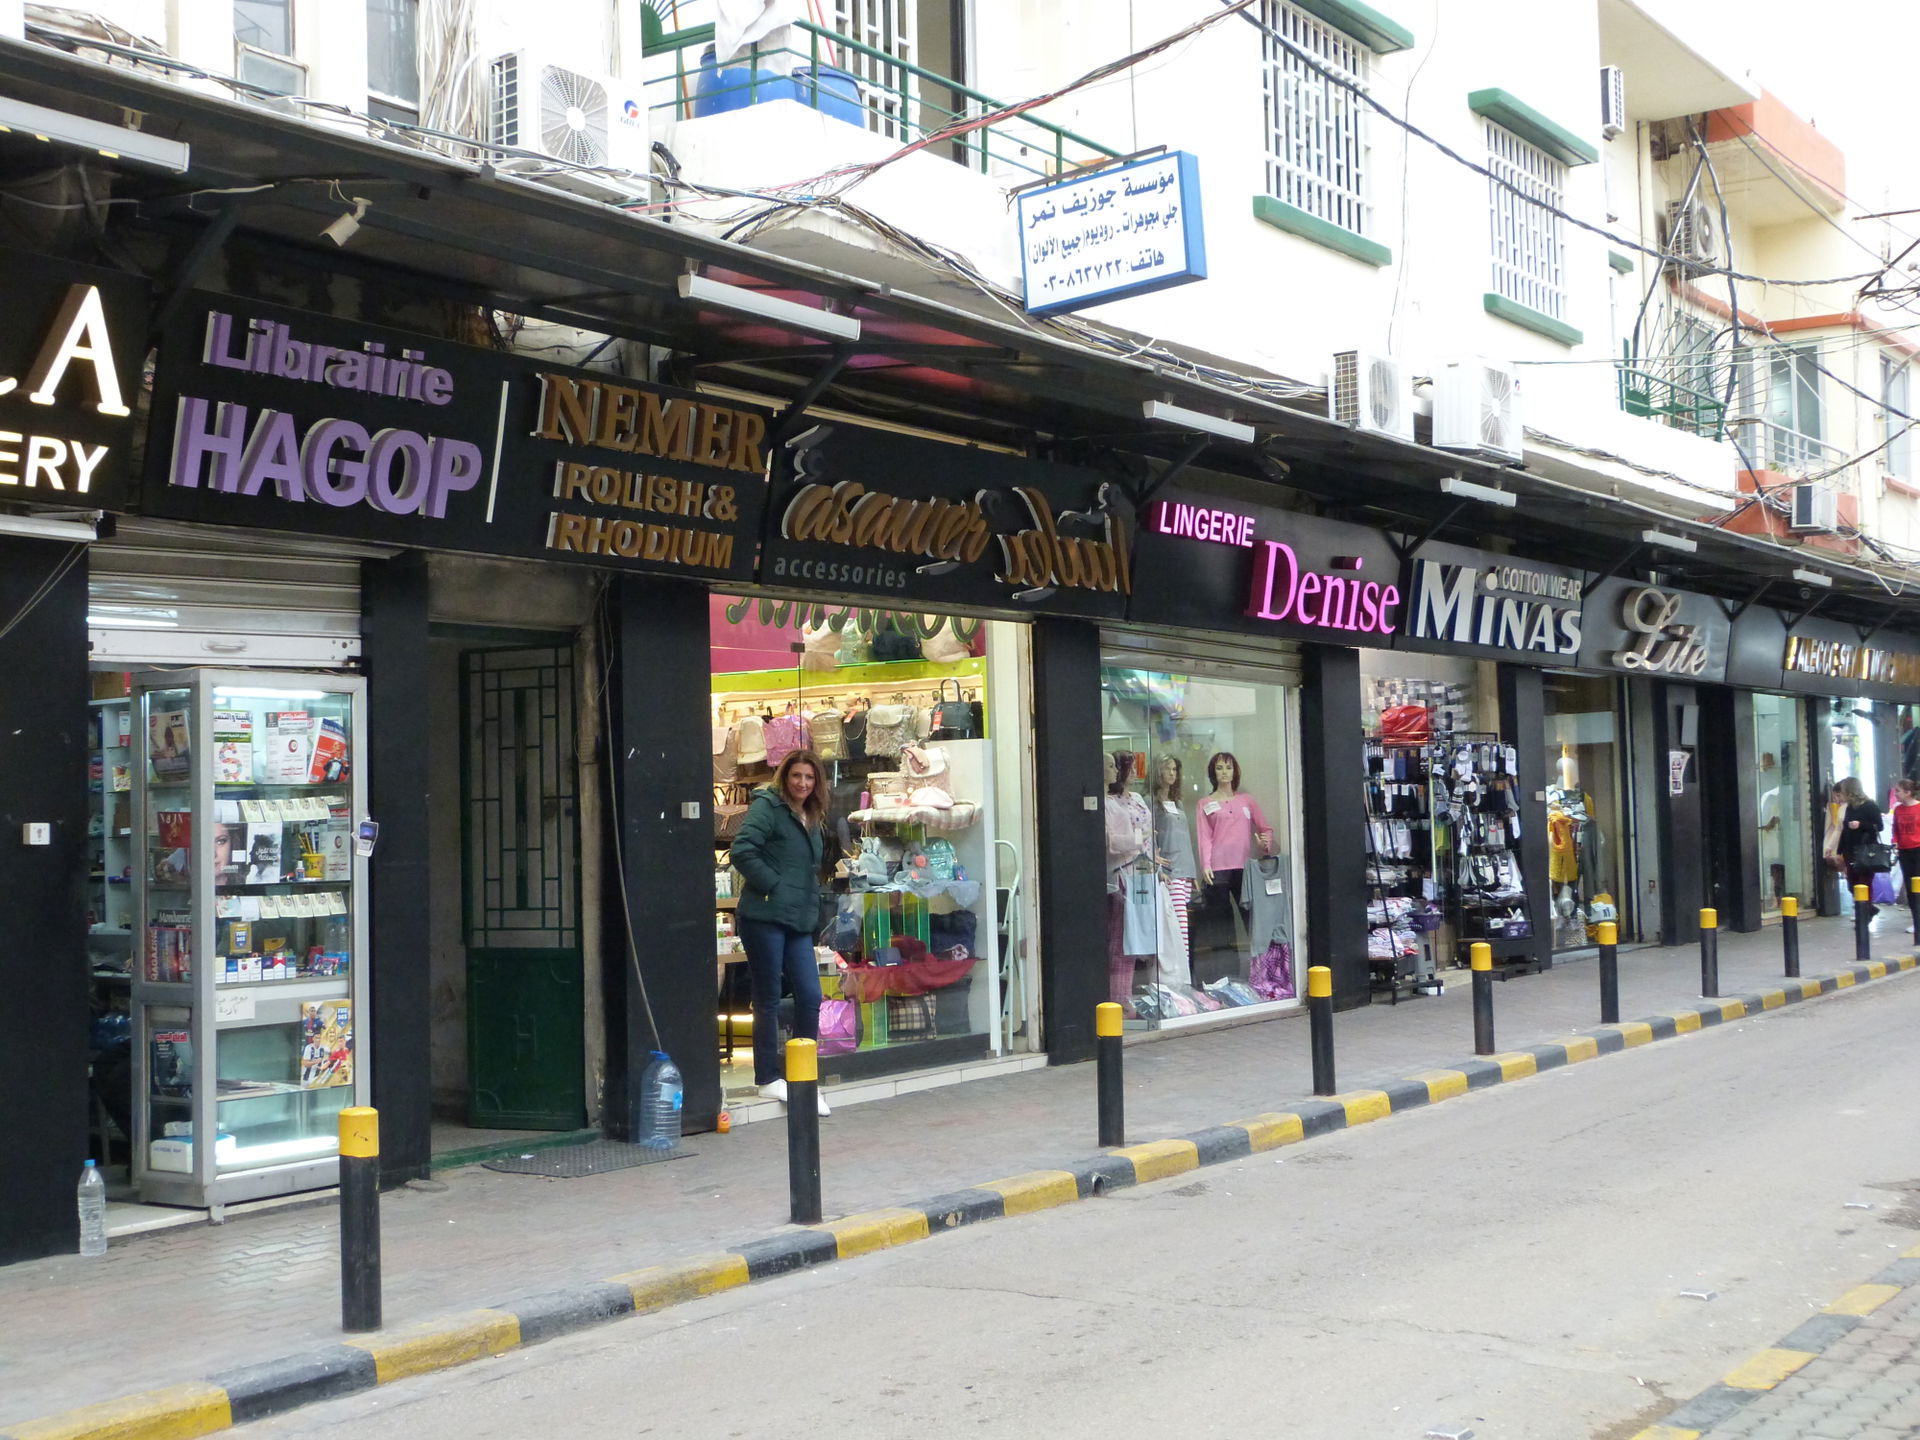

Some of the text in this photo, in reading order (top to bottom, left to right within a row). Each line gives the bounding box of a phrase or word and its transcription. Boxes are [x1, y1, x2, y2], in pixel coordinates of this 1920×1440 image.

[1028, 171, 1175, 228] مؤسسة جوزيف نمر
[203, 311, 454, 406] Librairie
[530, 372, 768, 474] NEMER
[169, 396, 483, 520] HAGOP
[554, 458, 739, 523] POLISH &
[546, 511, 735, 570] RHODIUM
[1157, 501, 1256, 549] LINGERIE
[774, 554, 908, 590] accessories
[1252, 540, 1400, 635] Denise
[1501, 567, 1582, 602] COTTON WEAR
